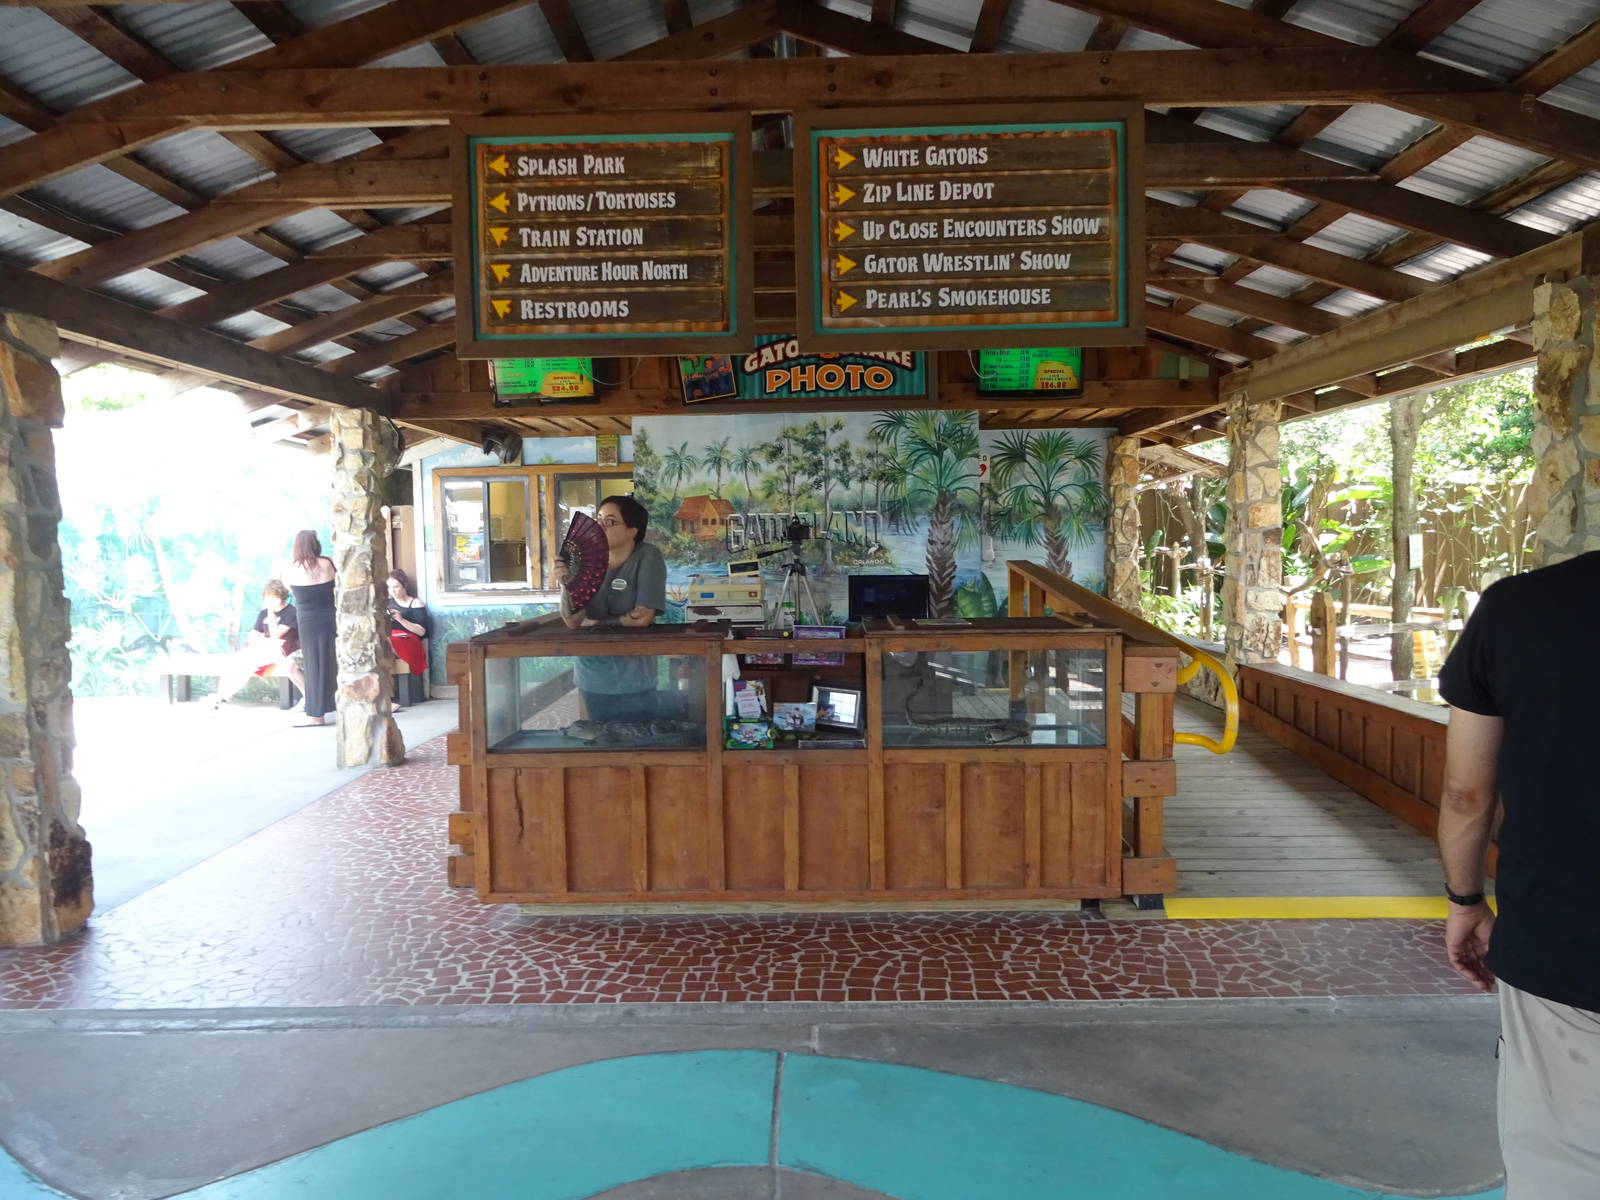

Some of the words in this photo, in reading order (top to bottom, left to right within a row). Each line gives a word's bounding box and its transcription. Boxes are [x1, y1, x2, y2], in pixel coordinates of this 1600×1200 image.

[517, 156, 578, 177] SPLASH
[583, 154, 625, 175] PARK
[862, 147, 920, 169] WHITE
[925, 145, 988, 166] GATORS
[863, 183, 892, 203] ZIP
[896, 182, 935, 202] LINE
[939, 180, 995, 201] DEPOT
[518, 227, 570, 248] TRAIN
[576, 226, 643, 246] STATION
[862, 220, 885, 241] UP
[889, 220, 939, 240] CLOSE
[943, 218, 1047, 238] ENCOUNTERS
[1051, 215, 1101, 236] SHOW
[519, 263, 599, 283] ADVENTURE
[601, 261, 640, 282] HOUR
[641, 260, 688, 281] NORTH
[864, 254, 919, 274] GATOR
[1020, 250, 1071, 271] SHOW
[938, 287, 1051, 307] SMOKEHOUSE
[520, 299, 629, 320] RESTROOMS
[744, 340, 799, 373] GATO
[765, 363, 894, 394] PHOTO
